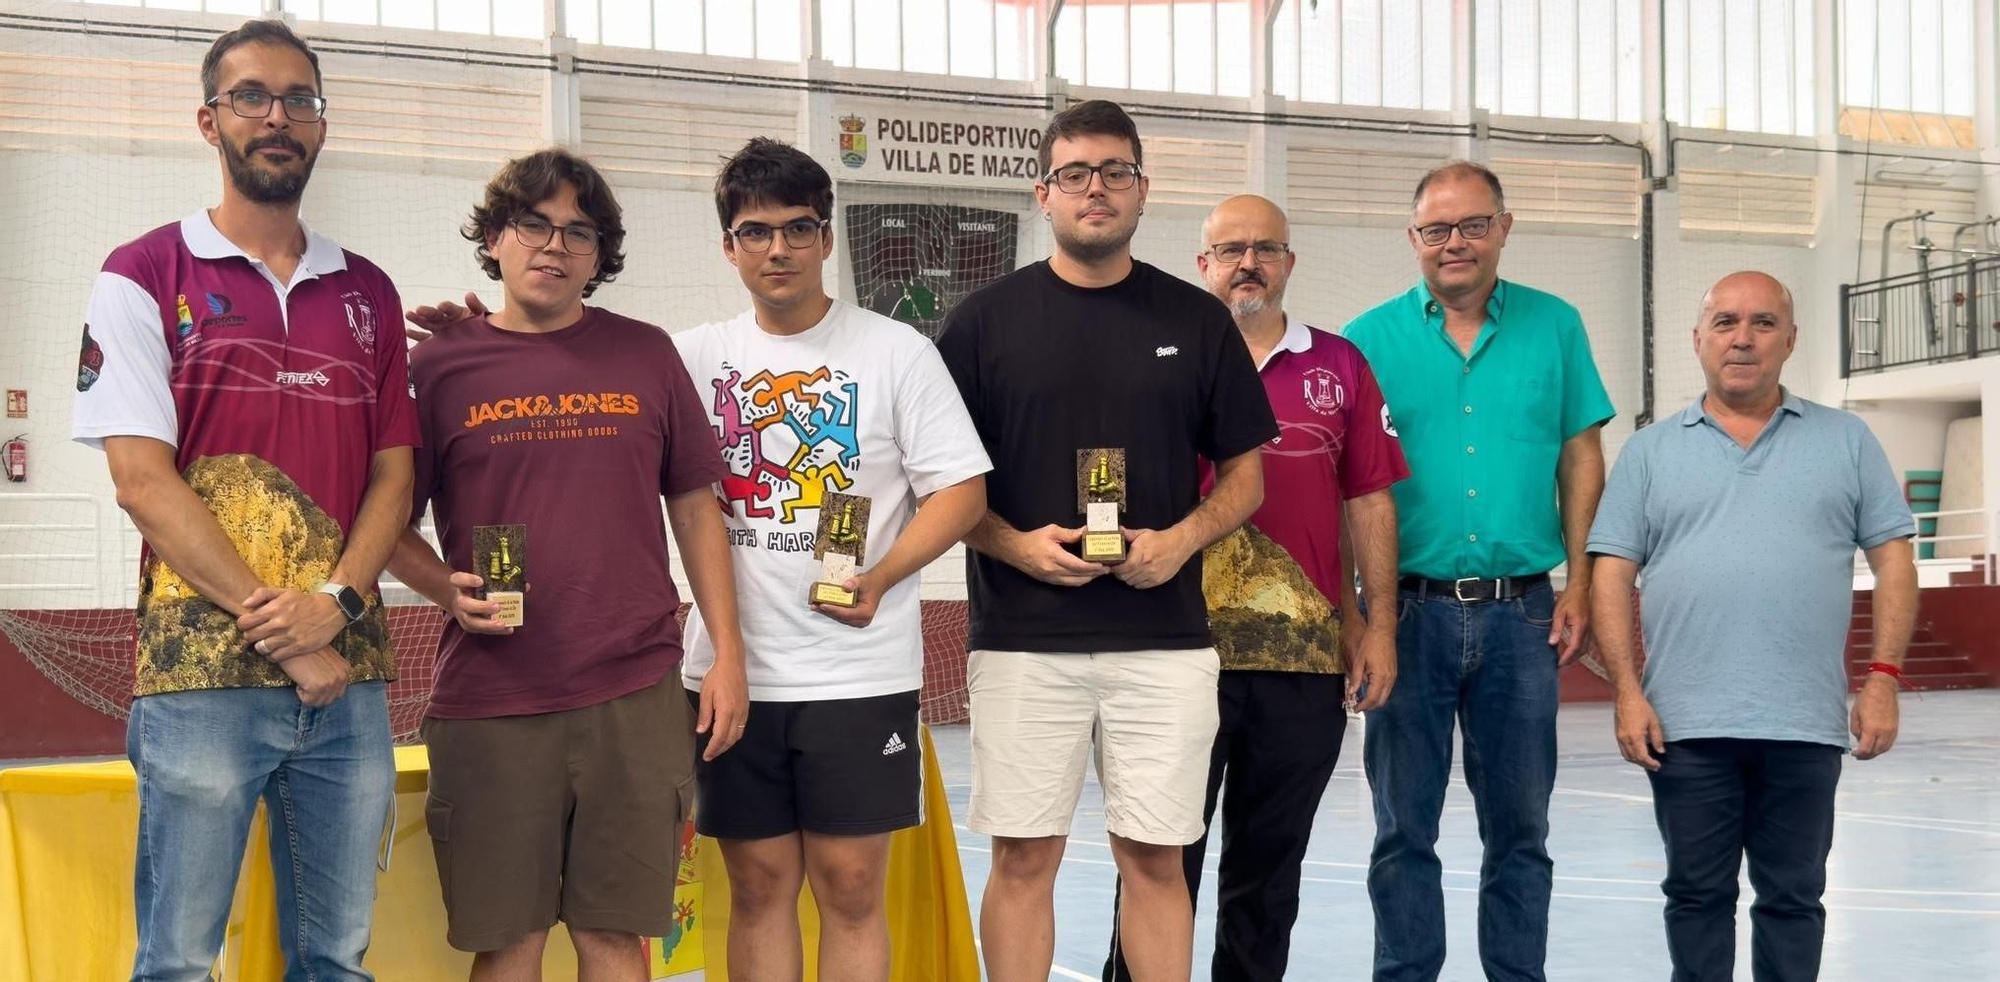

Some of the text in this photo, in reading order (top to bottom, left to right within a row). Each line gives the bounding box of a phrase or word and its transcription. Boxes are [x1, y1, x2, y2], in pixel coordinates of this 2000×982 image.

[877, 118, 1041, 150] POLIDEPORTIVO
[881, 149, 1039, 179] VILLA DE MAZO
[882, 218, 906, 228] LOCAL
[957, 222, 997, 232] VISITANTE
[490, 426, 618, 444] CRAFTED CLOTHING GOODS
[767, 532, 816, 552] HAR
[882, 742, 906, 756] adidas
